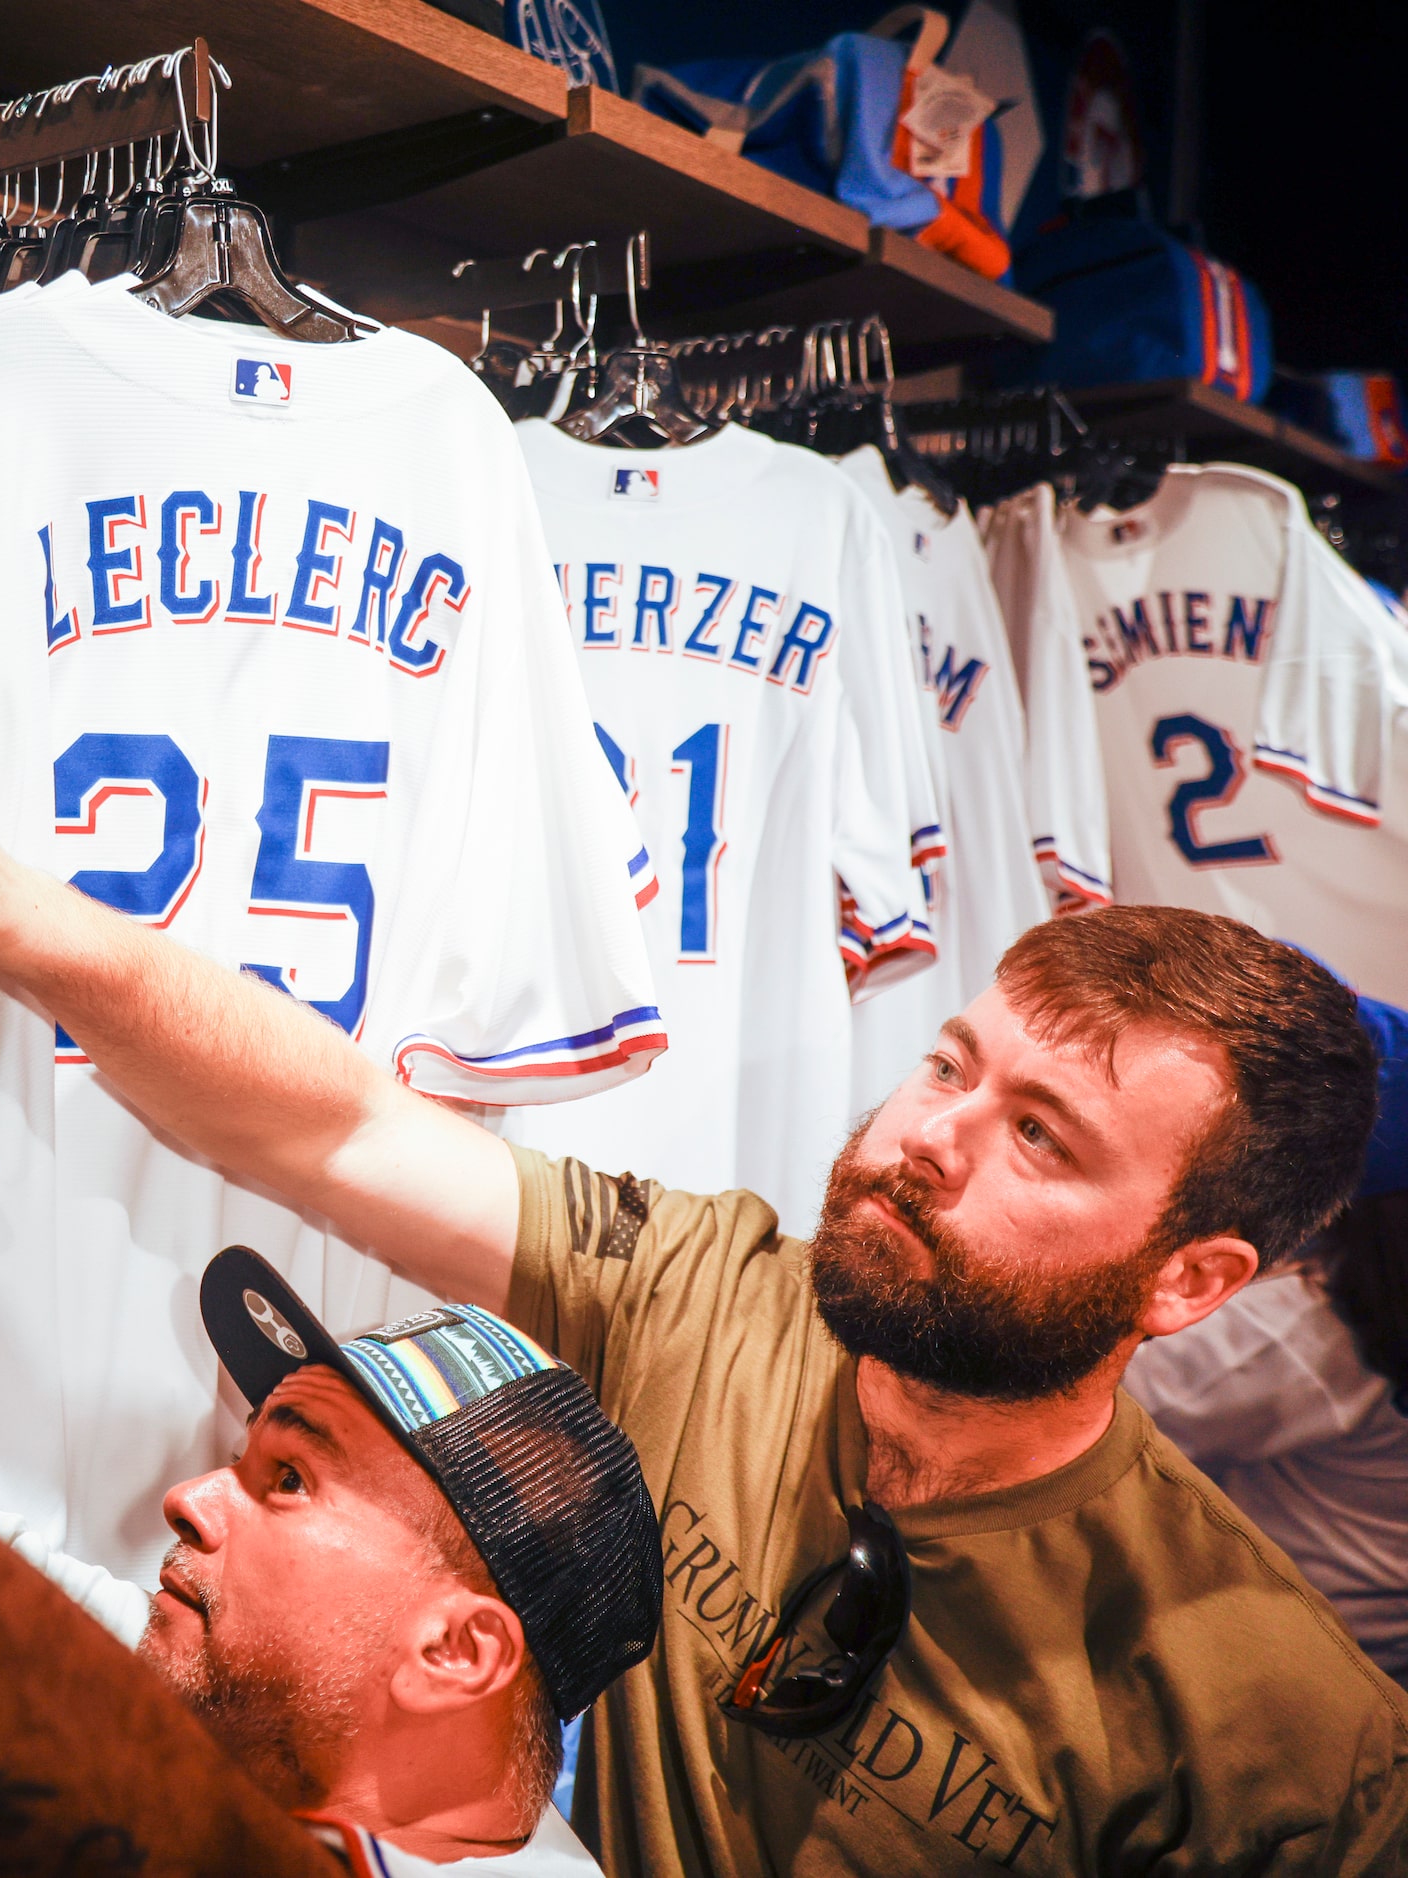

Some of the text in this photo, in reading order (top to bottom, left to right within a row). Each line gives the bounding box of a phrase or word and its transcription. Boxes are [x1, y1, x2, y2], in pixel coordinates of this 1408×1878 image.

[135, 182, 142, 193] S
[156, 182, 164, 194] S
[182, 186, 192, 197] S
[211, 180, 233, 193] XXL
[37, 490, 472, 679] LECLERC
[553, 563, 839, 696] ERZER
[593, 720, 730, 964] 1
[1149, 712, 1282, 872] 2
[53, 732, 391, 1064] 25
[660, 1500, 814, 1688] GRUMY
[929, 1731, 1059, 1871] VET
[803, 1749, 870, 1817] WANT
